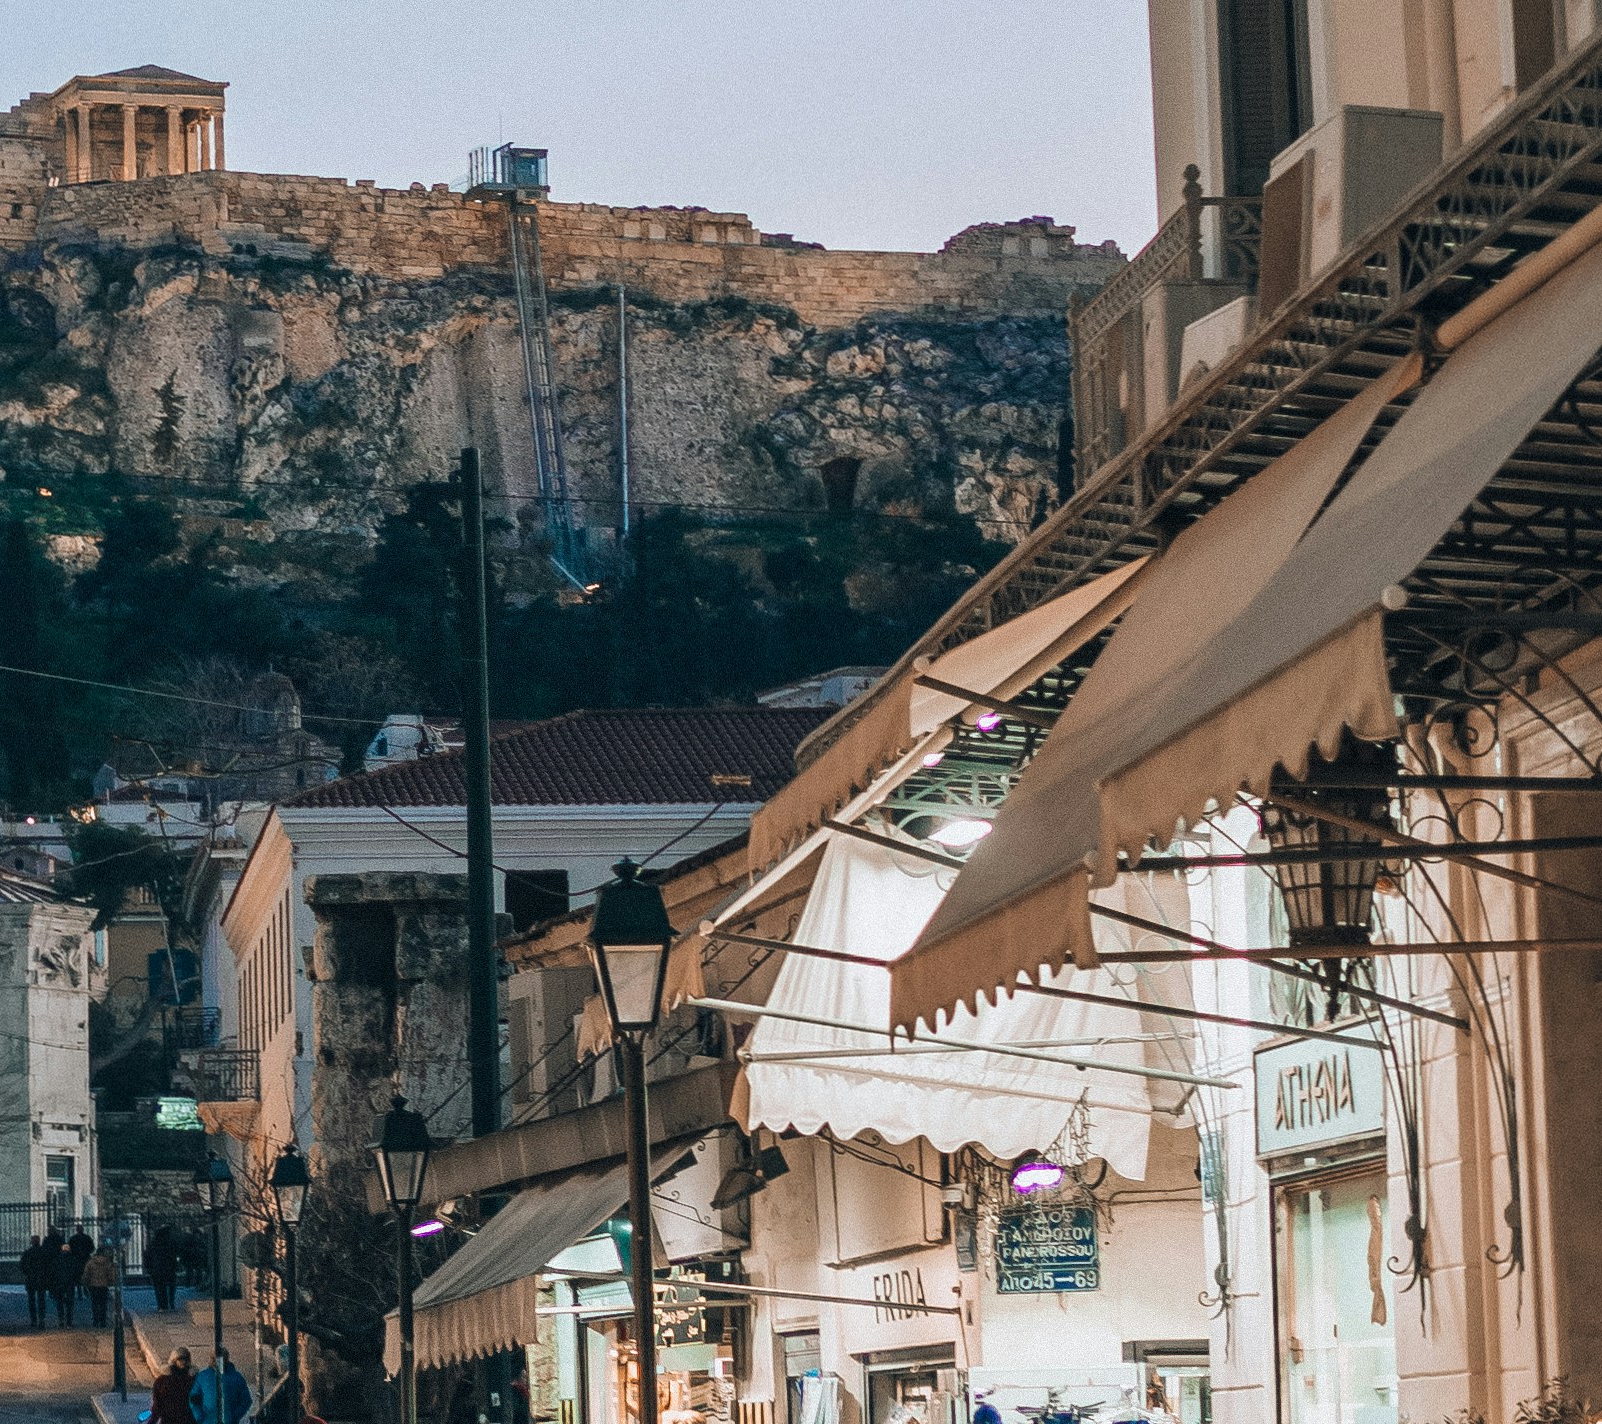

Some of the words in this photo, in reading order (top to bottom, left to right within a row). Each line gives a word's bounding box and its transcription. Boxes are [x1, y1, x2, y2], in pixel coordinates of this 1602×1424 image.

[1274, 1046, 1355, 1130] ATHENA
[873, 1267, 929, 1324] FRIDA
[1074, 1270, 1097, 1288] 69
